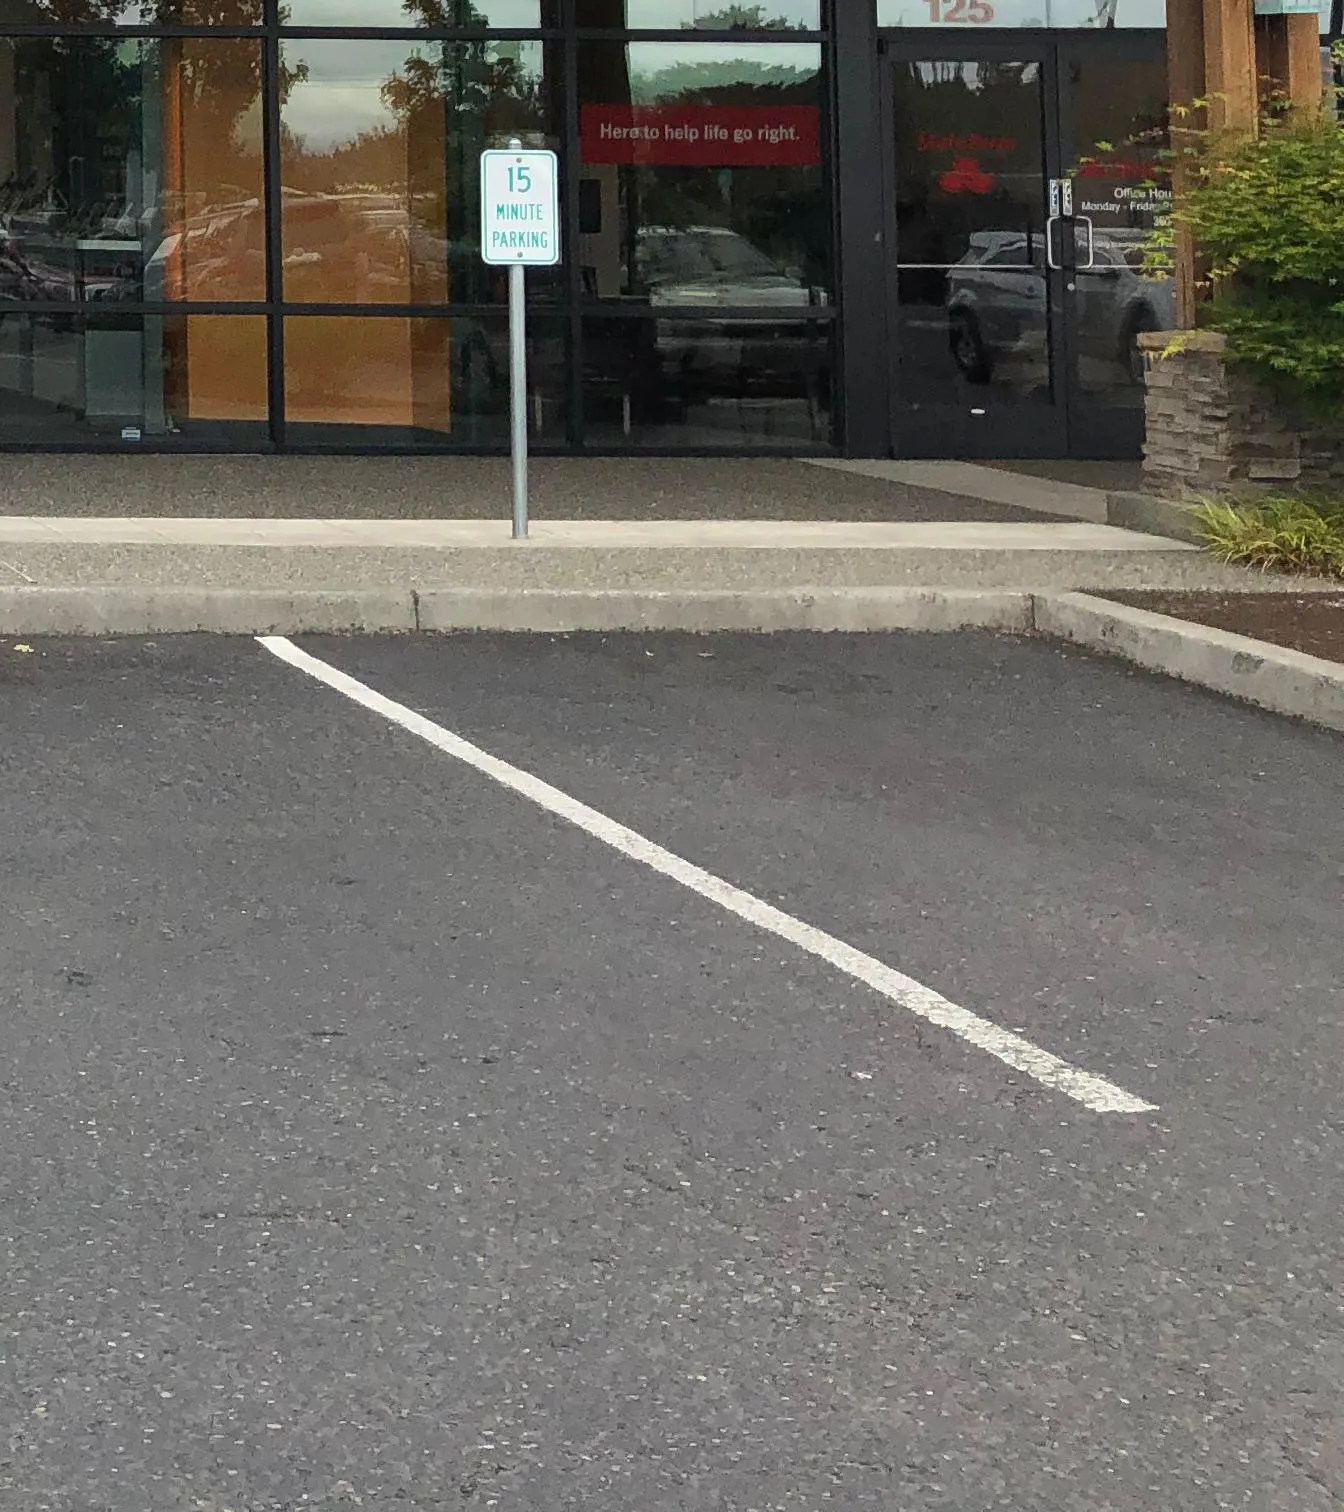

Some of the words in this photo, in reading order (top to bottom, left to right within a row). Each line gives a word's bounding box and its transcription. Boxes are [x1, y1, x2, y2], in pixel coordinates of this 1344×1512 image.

[600, 123, 639, 139] Here
[644, 125, 660, 139] to
[664, 124, 699, 142] help
[704, 124, 729, 140] life
[733, 128, 753, 143] go
[758, 125, 800, 143] right.
[508, 166, 532, 193] 15
[1149, 188, 1172, 198] Hou
[496, 204, 544, 220] MINUTE
[1082, 201, 1121, 214] Monday
[1130, 201, 1158, 211] Frida
[492, 231, 548, 249] PARKING
